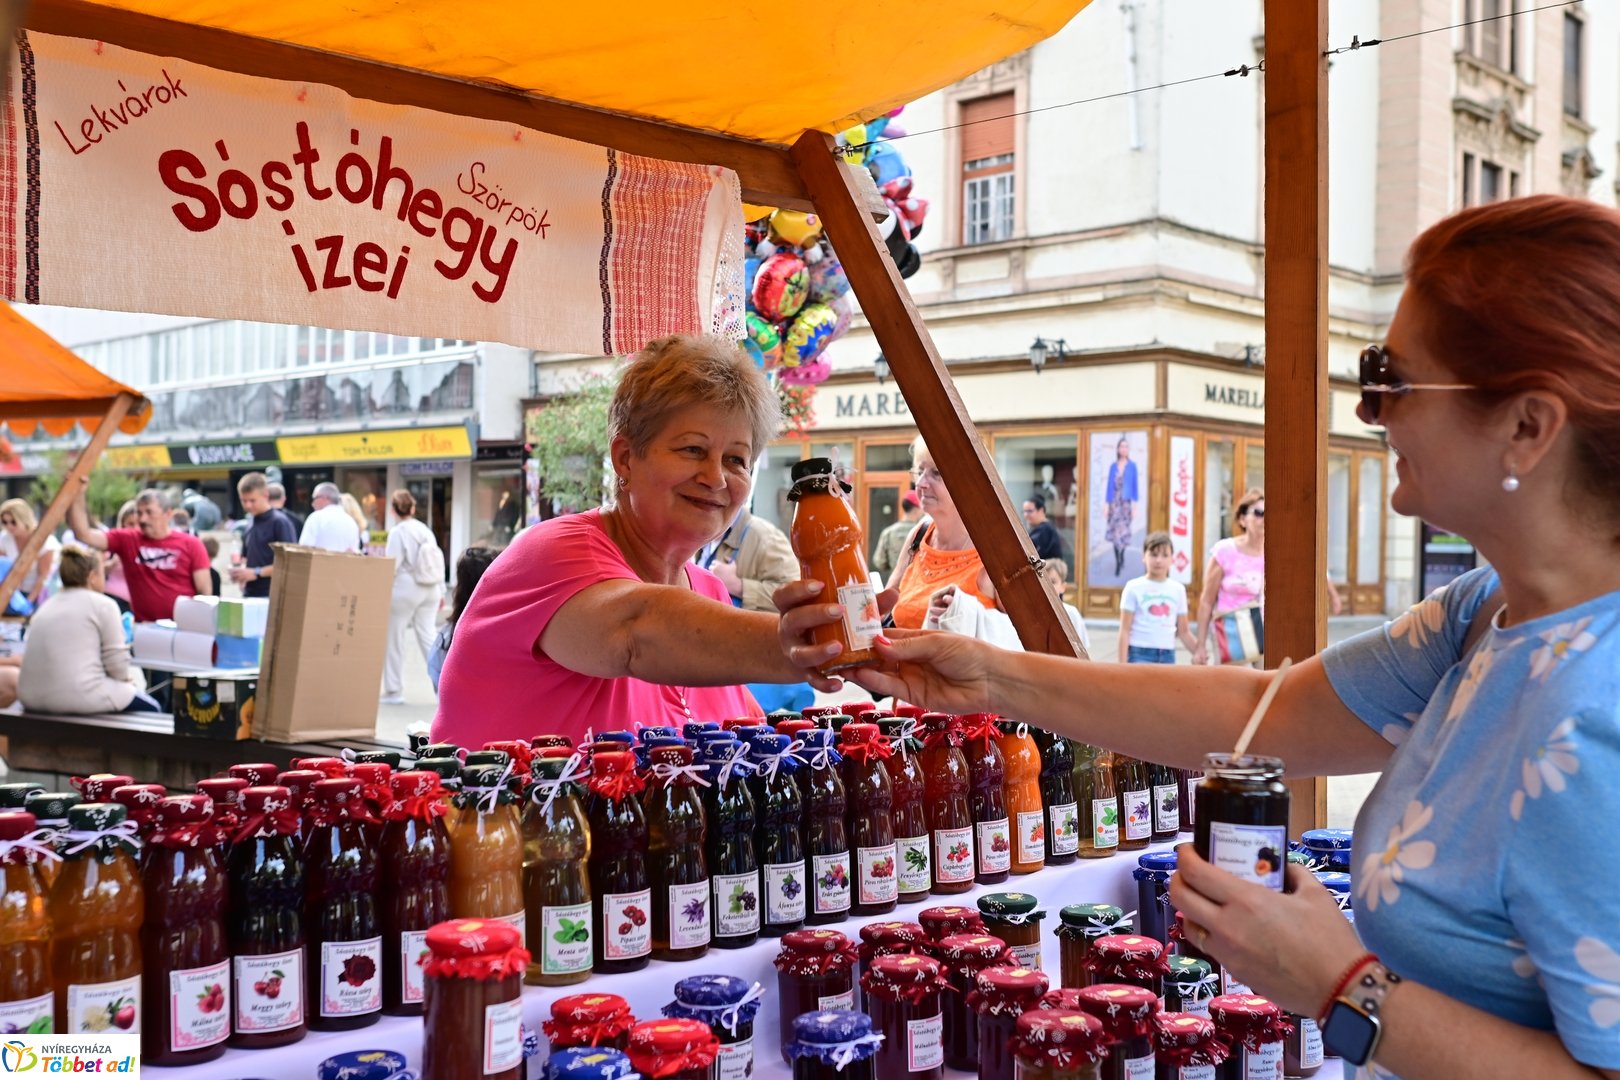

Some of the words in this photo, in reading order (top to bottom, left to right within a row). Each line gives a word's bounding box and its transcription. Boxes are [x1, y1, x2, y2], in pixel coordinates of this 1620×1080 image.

[54, 69, 188, 155] Lekvárok
[158, 121, 519, 303] Sóstóhegy
[457, 162, 551, 240] Szörpök
